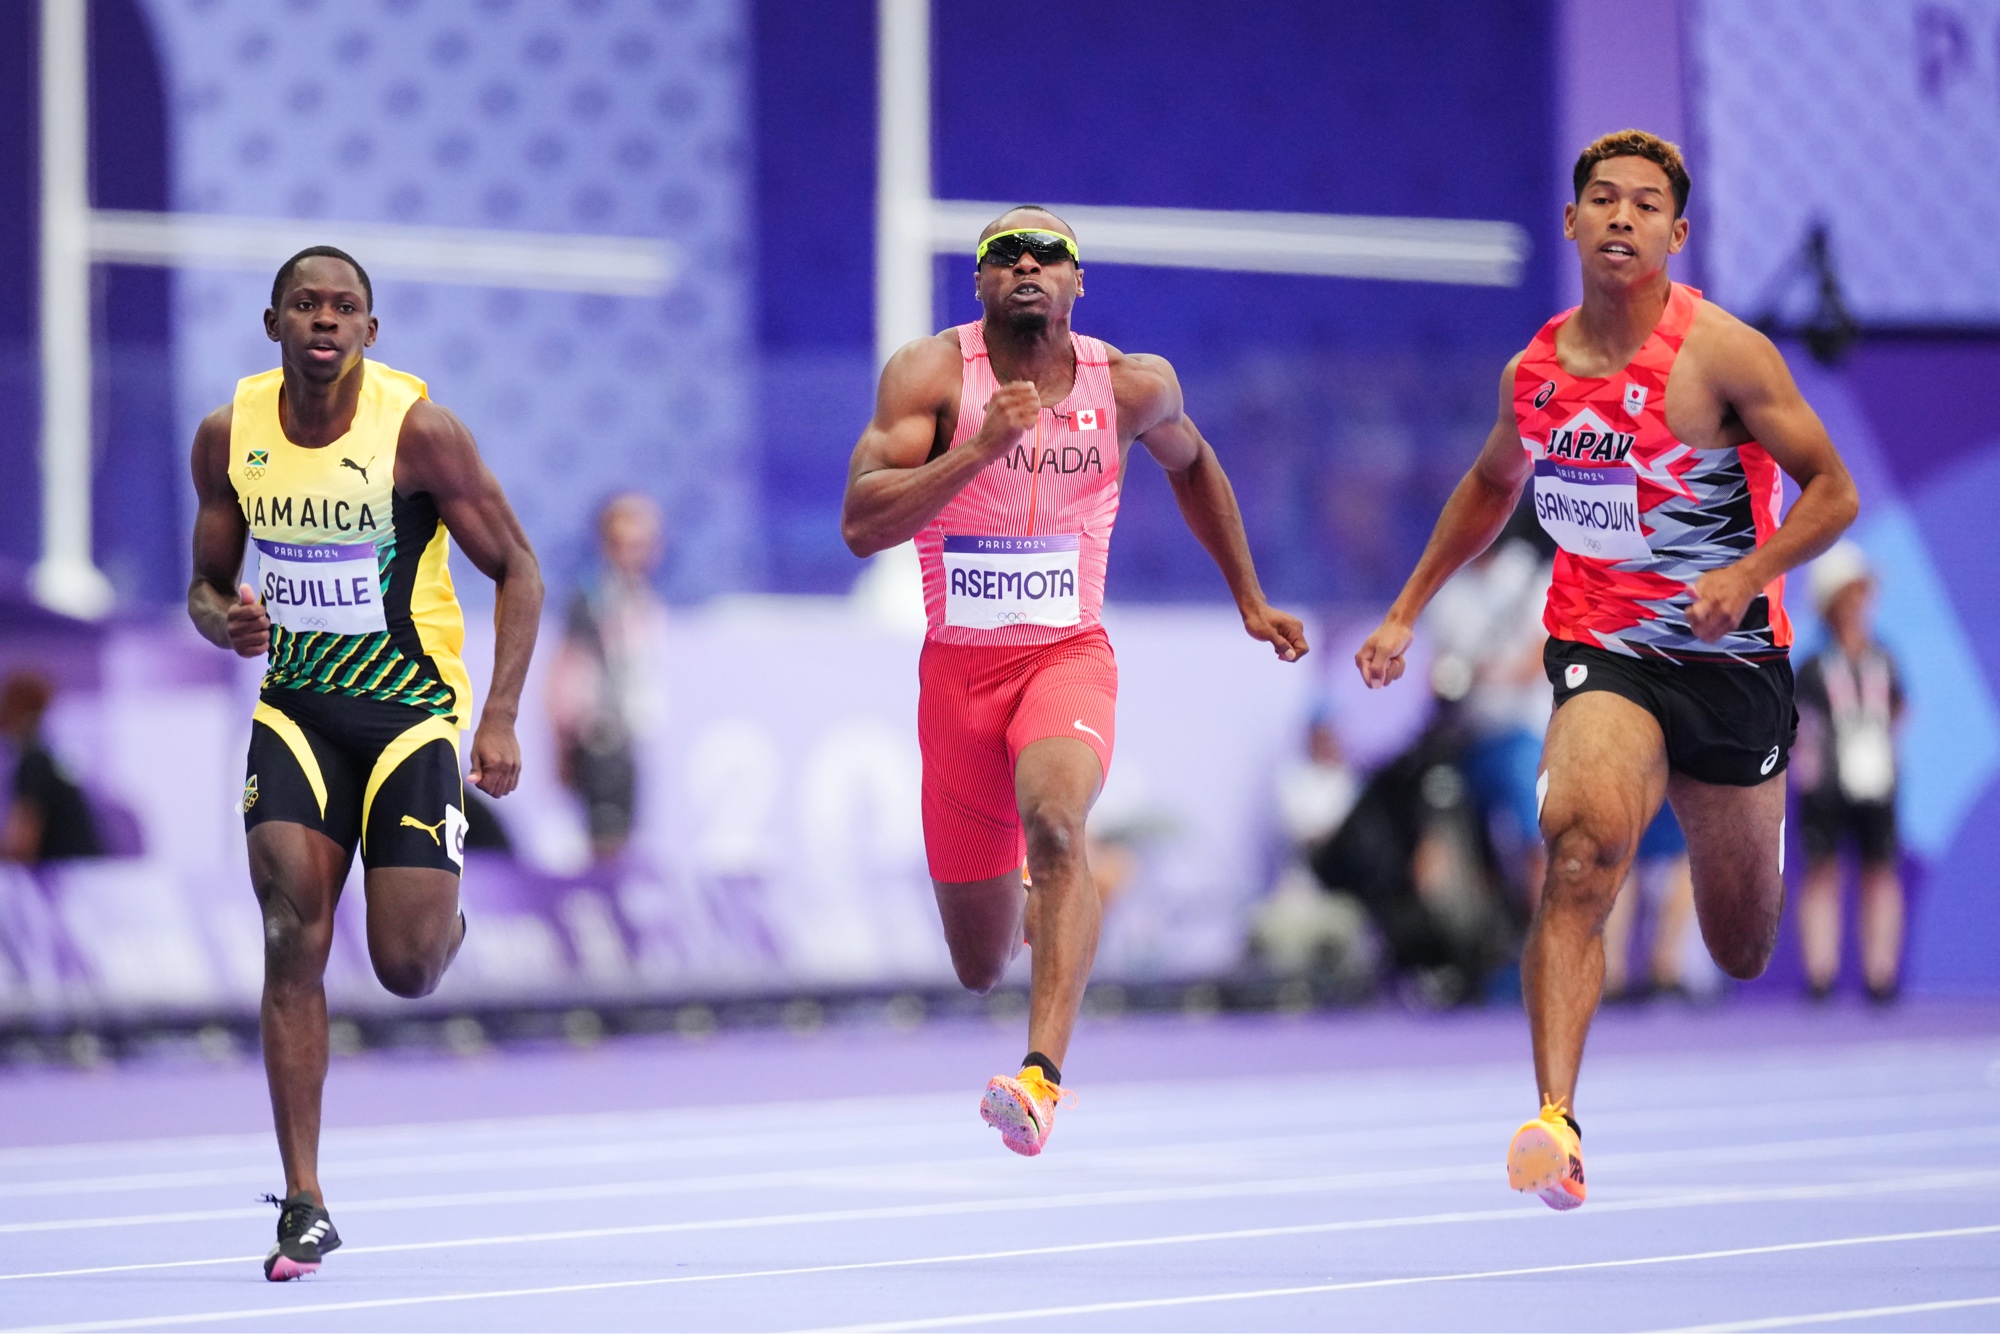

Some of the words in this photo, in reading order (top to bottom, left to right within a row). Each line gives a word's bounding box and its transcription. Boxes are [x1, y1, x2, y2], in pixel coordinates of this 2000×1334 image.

[1006, 444, 1103, 474] NADA
[1546, 428, 1636, 462] JAPAN
[1578, 471, 1605, 481] 2024
[246, 496, 377, 532] JAMAICA
[1535, 491, 1575, 523] SANI
[1571, 498, 1637, 532] BROWN
[274, 546, 304, 558] PARIS
[306, 549, 339, 559] 2024
[978, 540, 1012, 550] PARIS
[1016, 540, 1047, 550] 2024
[263, 571, 372, 607] SEVILLE
[951, 567, 1075, 600] ASEMOTA
[454, 823, 464, 856] 6
